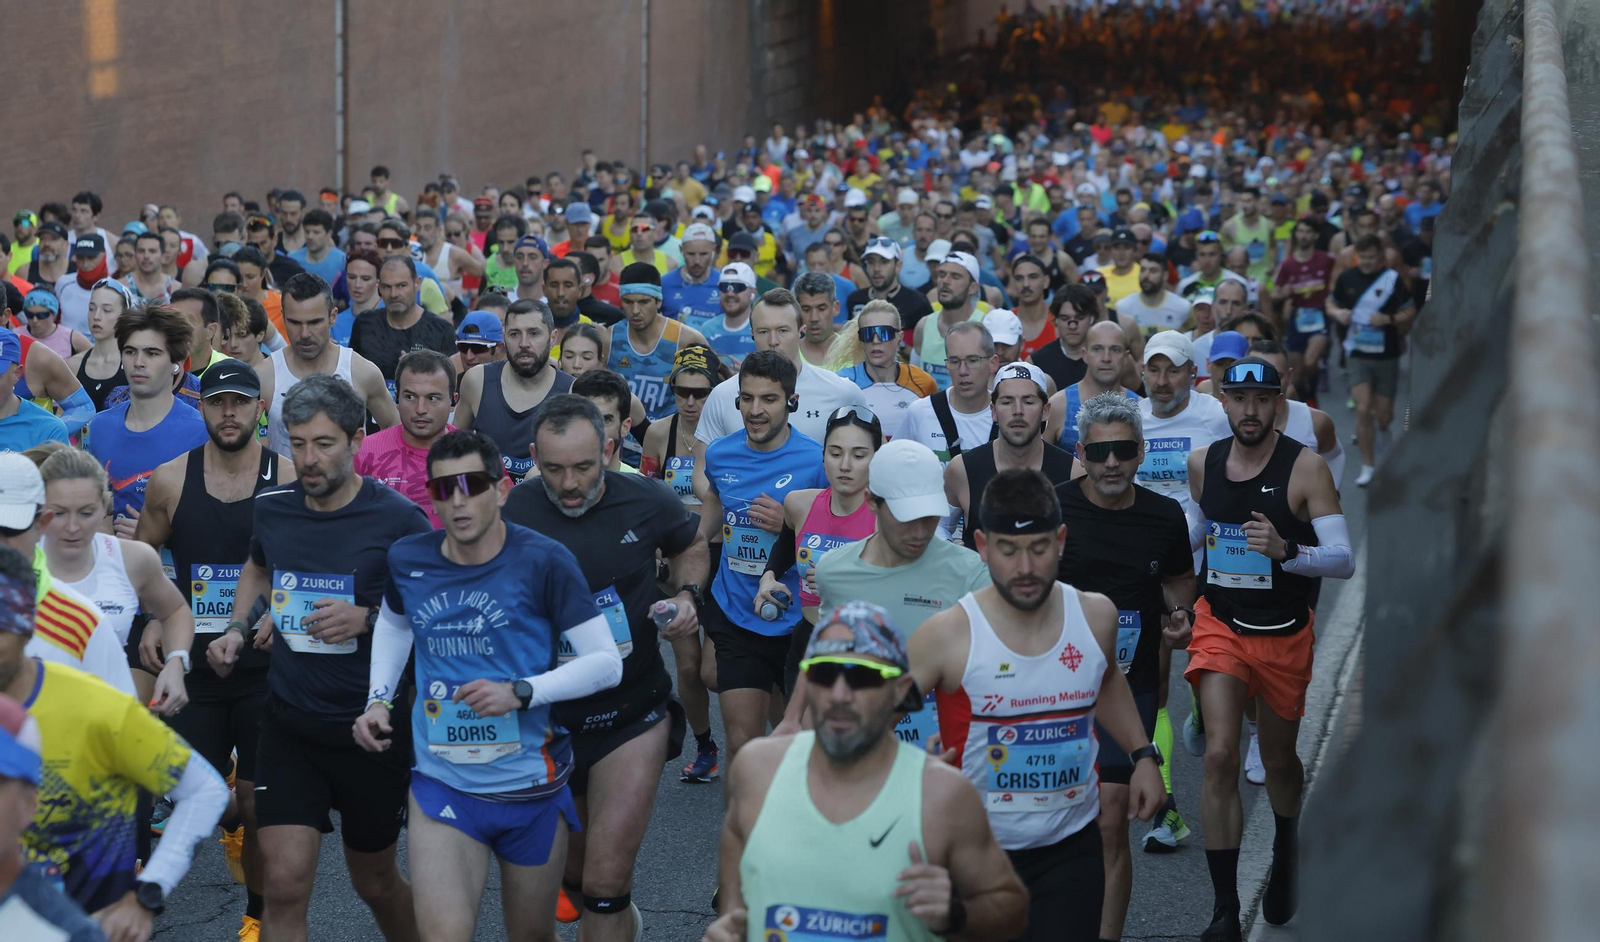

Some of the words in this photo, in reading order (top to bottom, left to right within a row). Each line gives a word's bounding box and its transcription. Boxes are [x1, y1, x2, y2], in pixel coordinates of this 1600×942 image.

[1152, 441, 1184, 449] ZURICH
[1152, 458, 1168, 466] 5131
[1151, 470, 1175, 480] ALEX
[741, 534, 759, 544] 6592
[737, 545, 768, 560] ATILA
[1225, 546, 1246, 556] 7916
[301, 577, 344, 590] ZURICH
[412, 592, 450, 629] SAINT
[457, 590, 509, 628] LAURENT
[427, 637, 494, 658] RUNNING
[1010, 696, 1056, 708] Running
[1058, 690, 1095, 702] Mellaria
[585, 710, 618, 723] COMP
[447, 725, 497, 742] BORIS
[1026, 754, 1056, 766] 4718
[996, 767, 1080, 789] CRISTIAN
[805, 912, 873, 935] ZURICH
